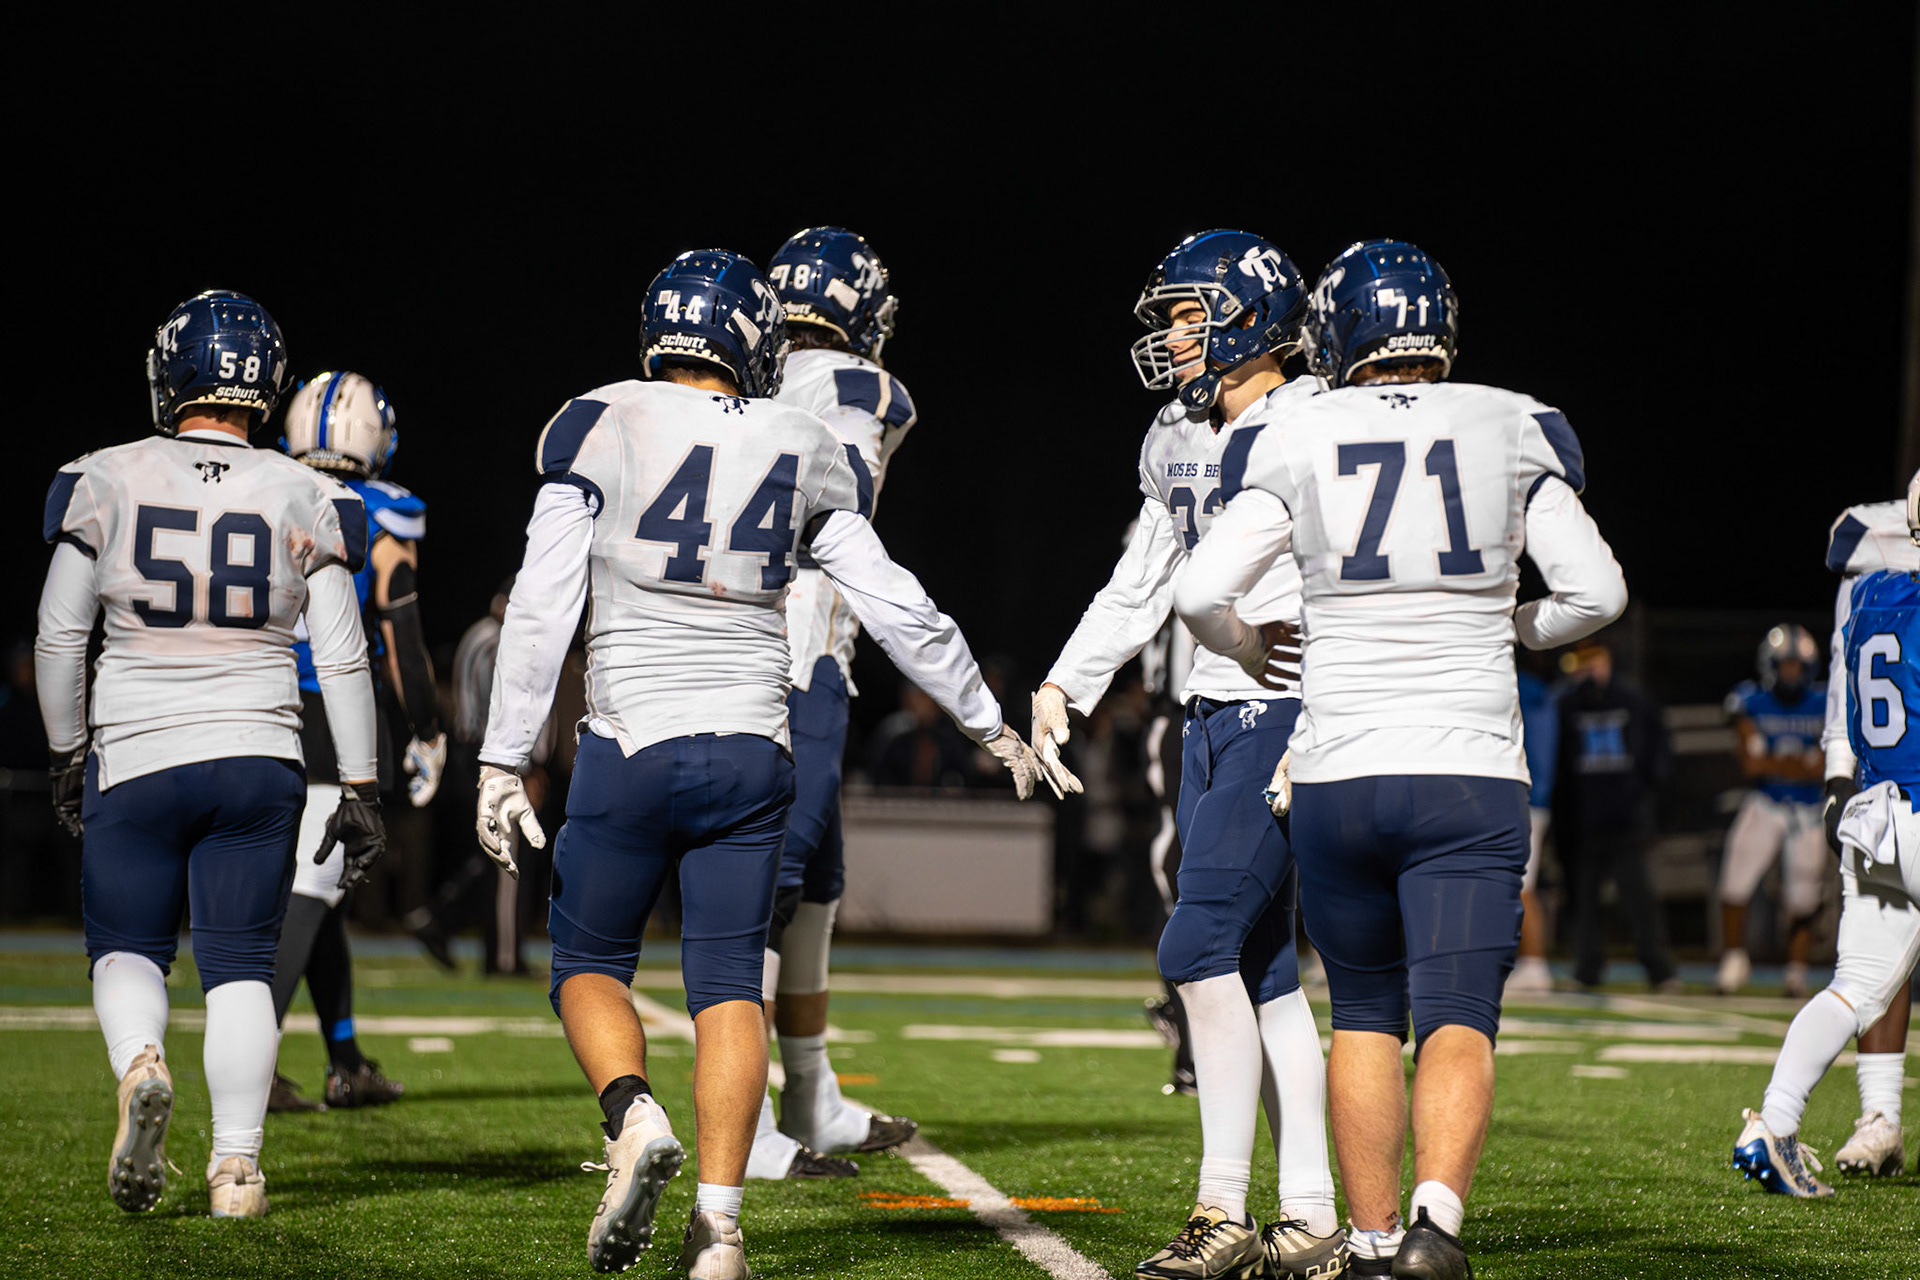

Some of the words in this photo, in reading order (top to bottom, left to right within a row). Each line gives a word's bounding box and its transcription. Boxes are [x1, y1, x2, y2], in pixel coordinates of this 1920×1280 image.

[771, 264, 811, 291] 78
[664, 294, 703, 325] 44
[1389, 294, 1427, 329] 71
[659, 331, 708, 350] schutt
[1387, 332, 1436, 350] schutt
[218, 351, 261, 384] 58
[215, 384, 260, 400] schutt
[1166, 462, 1198, 478] MOSES
[630, 441, 803, 592] 44
[1334, 437, 1487, 582] 71
[130, 502, 273, 630] 58
[1857, 632, 1907, 749] 6
